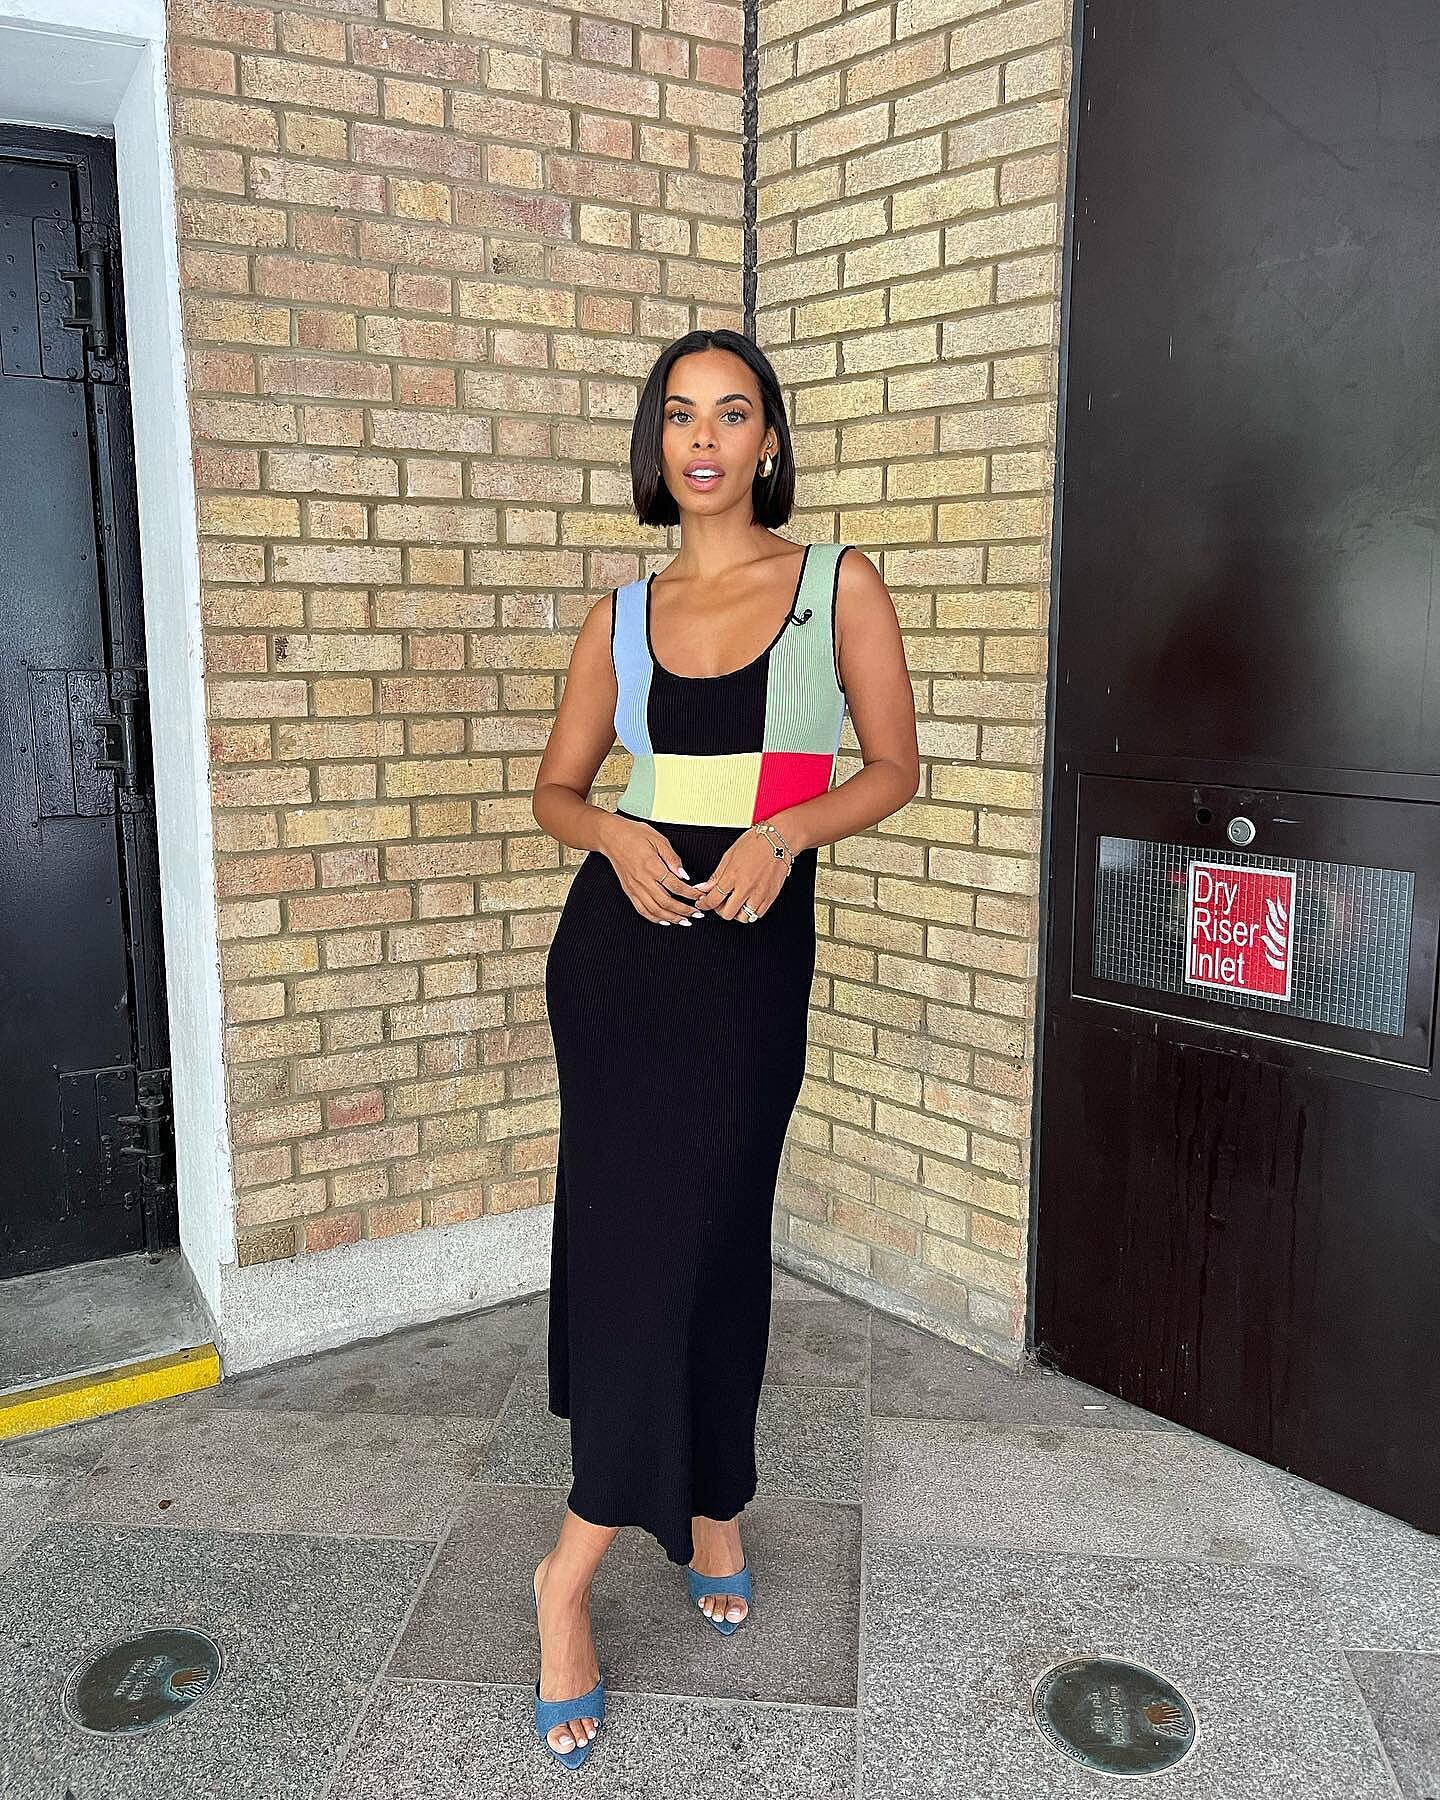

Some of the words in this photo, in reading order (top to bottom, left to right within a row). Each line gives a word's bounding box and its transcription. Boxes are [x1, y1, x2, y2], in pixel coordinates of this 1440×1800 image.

[1195, 870, 1238, 914] Dry
[1193, 906, 1260, 948] Riser
[1191, 944, 1244, 984] Inlet
[1042, 1723, 1087, 1762] FOUNDATION
